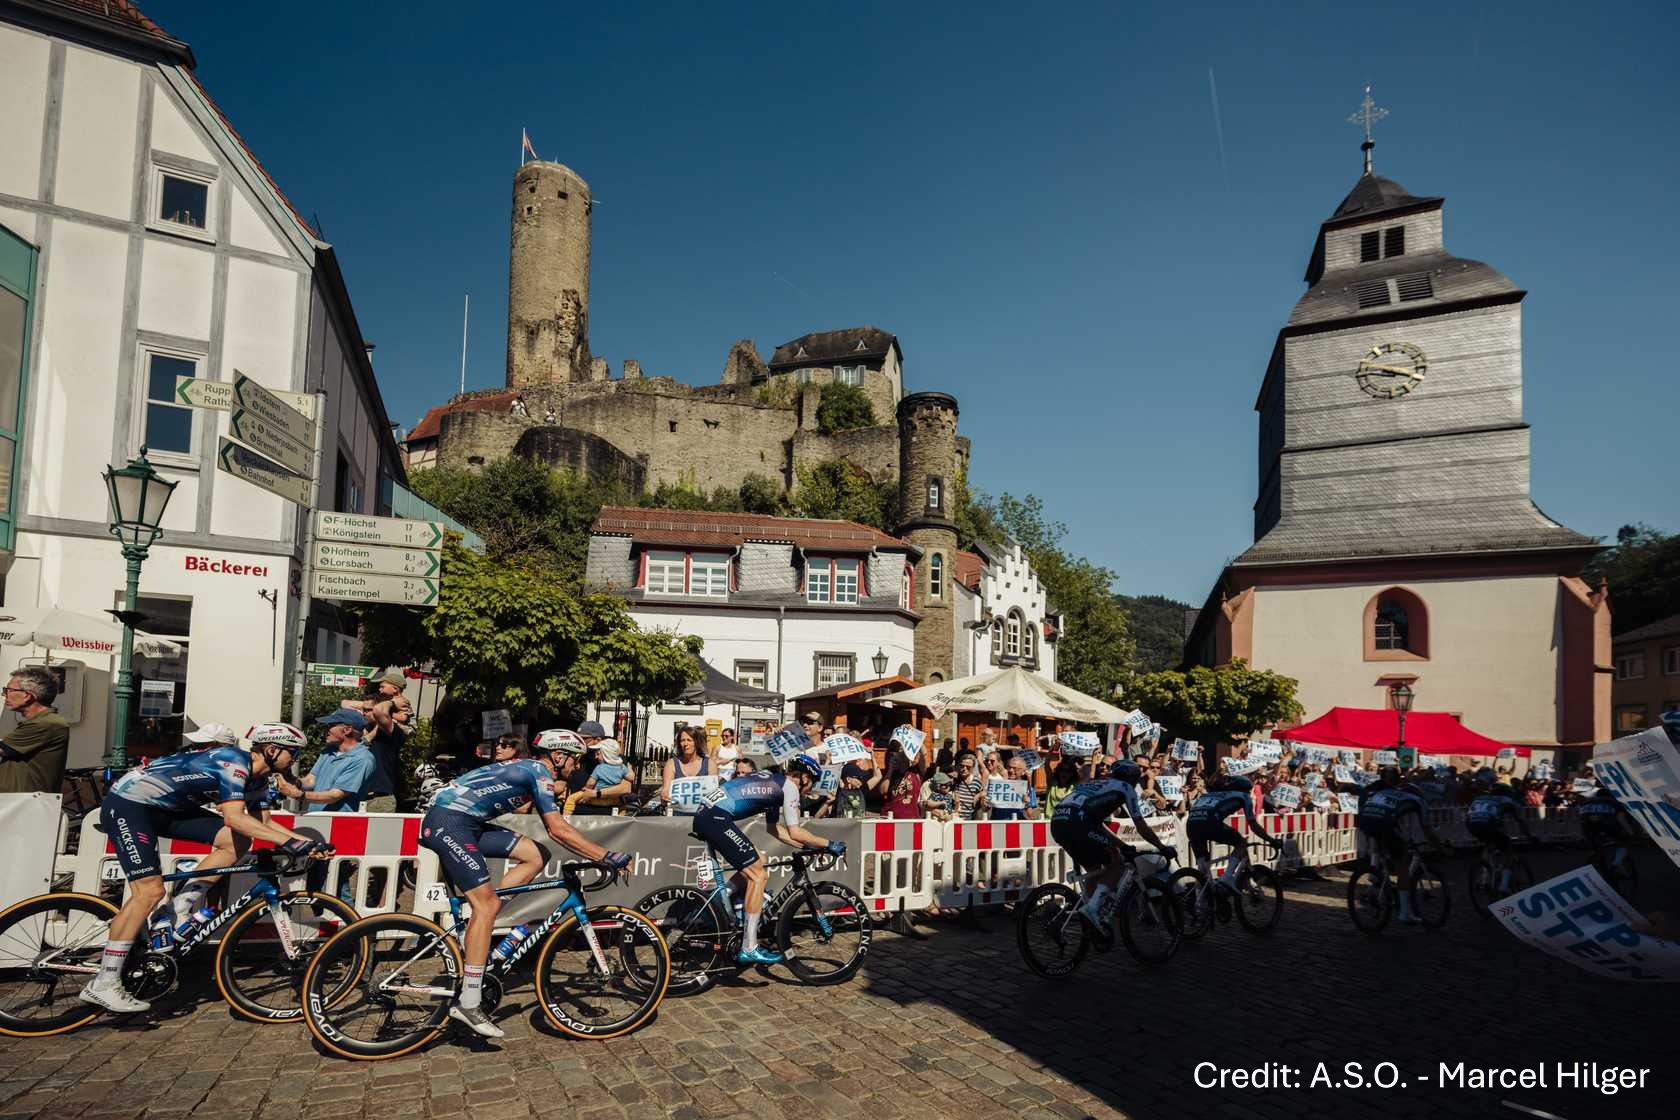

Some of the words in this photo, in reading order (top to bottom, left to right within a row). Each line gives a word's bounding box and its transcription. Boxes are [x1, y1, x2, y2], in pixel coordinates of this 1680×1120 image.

[333, 528, 381, 540] Königstein
[331, 546, 370, 557] Hofheim
[185, 556, 268, 577] Bäckerei
[330, 559, 373, 569] Lorsbach
[319, 574, 366, 585] Fischbach
[318, 586, 380, 599] Kaisertempel
[61, 636, 114, 652] Weissbier
[473, 782, 513, 798] SOUDAL
[671, 782, 707, 795] EPP-
[741, 786, 773, 796] FACTOR
[988, 783, 1015, 792] EPP-
[987, 792, 1025, 803] STEIN
[106, 867, 119, 879] 41
[426, 889, 440, 901] 42
[259, 897, 318, 916] rval
[623, 894, 662, 943] BLCK
[668, 888, 696, 900] INC
[832, 885, 869, 921] BLACK
[858, 928, 870, 956] INC
[180, 890, 252, 956] S-WORKS
[612, 911, 661, 942] roval
[502, 907, 562, 975] S-WORKS
[548, 1002, 594, 1033] roval
